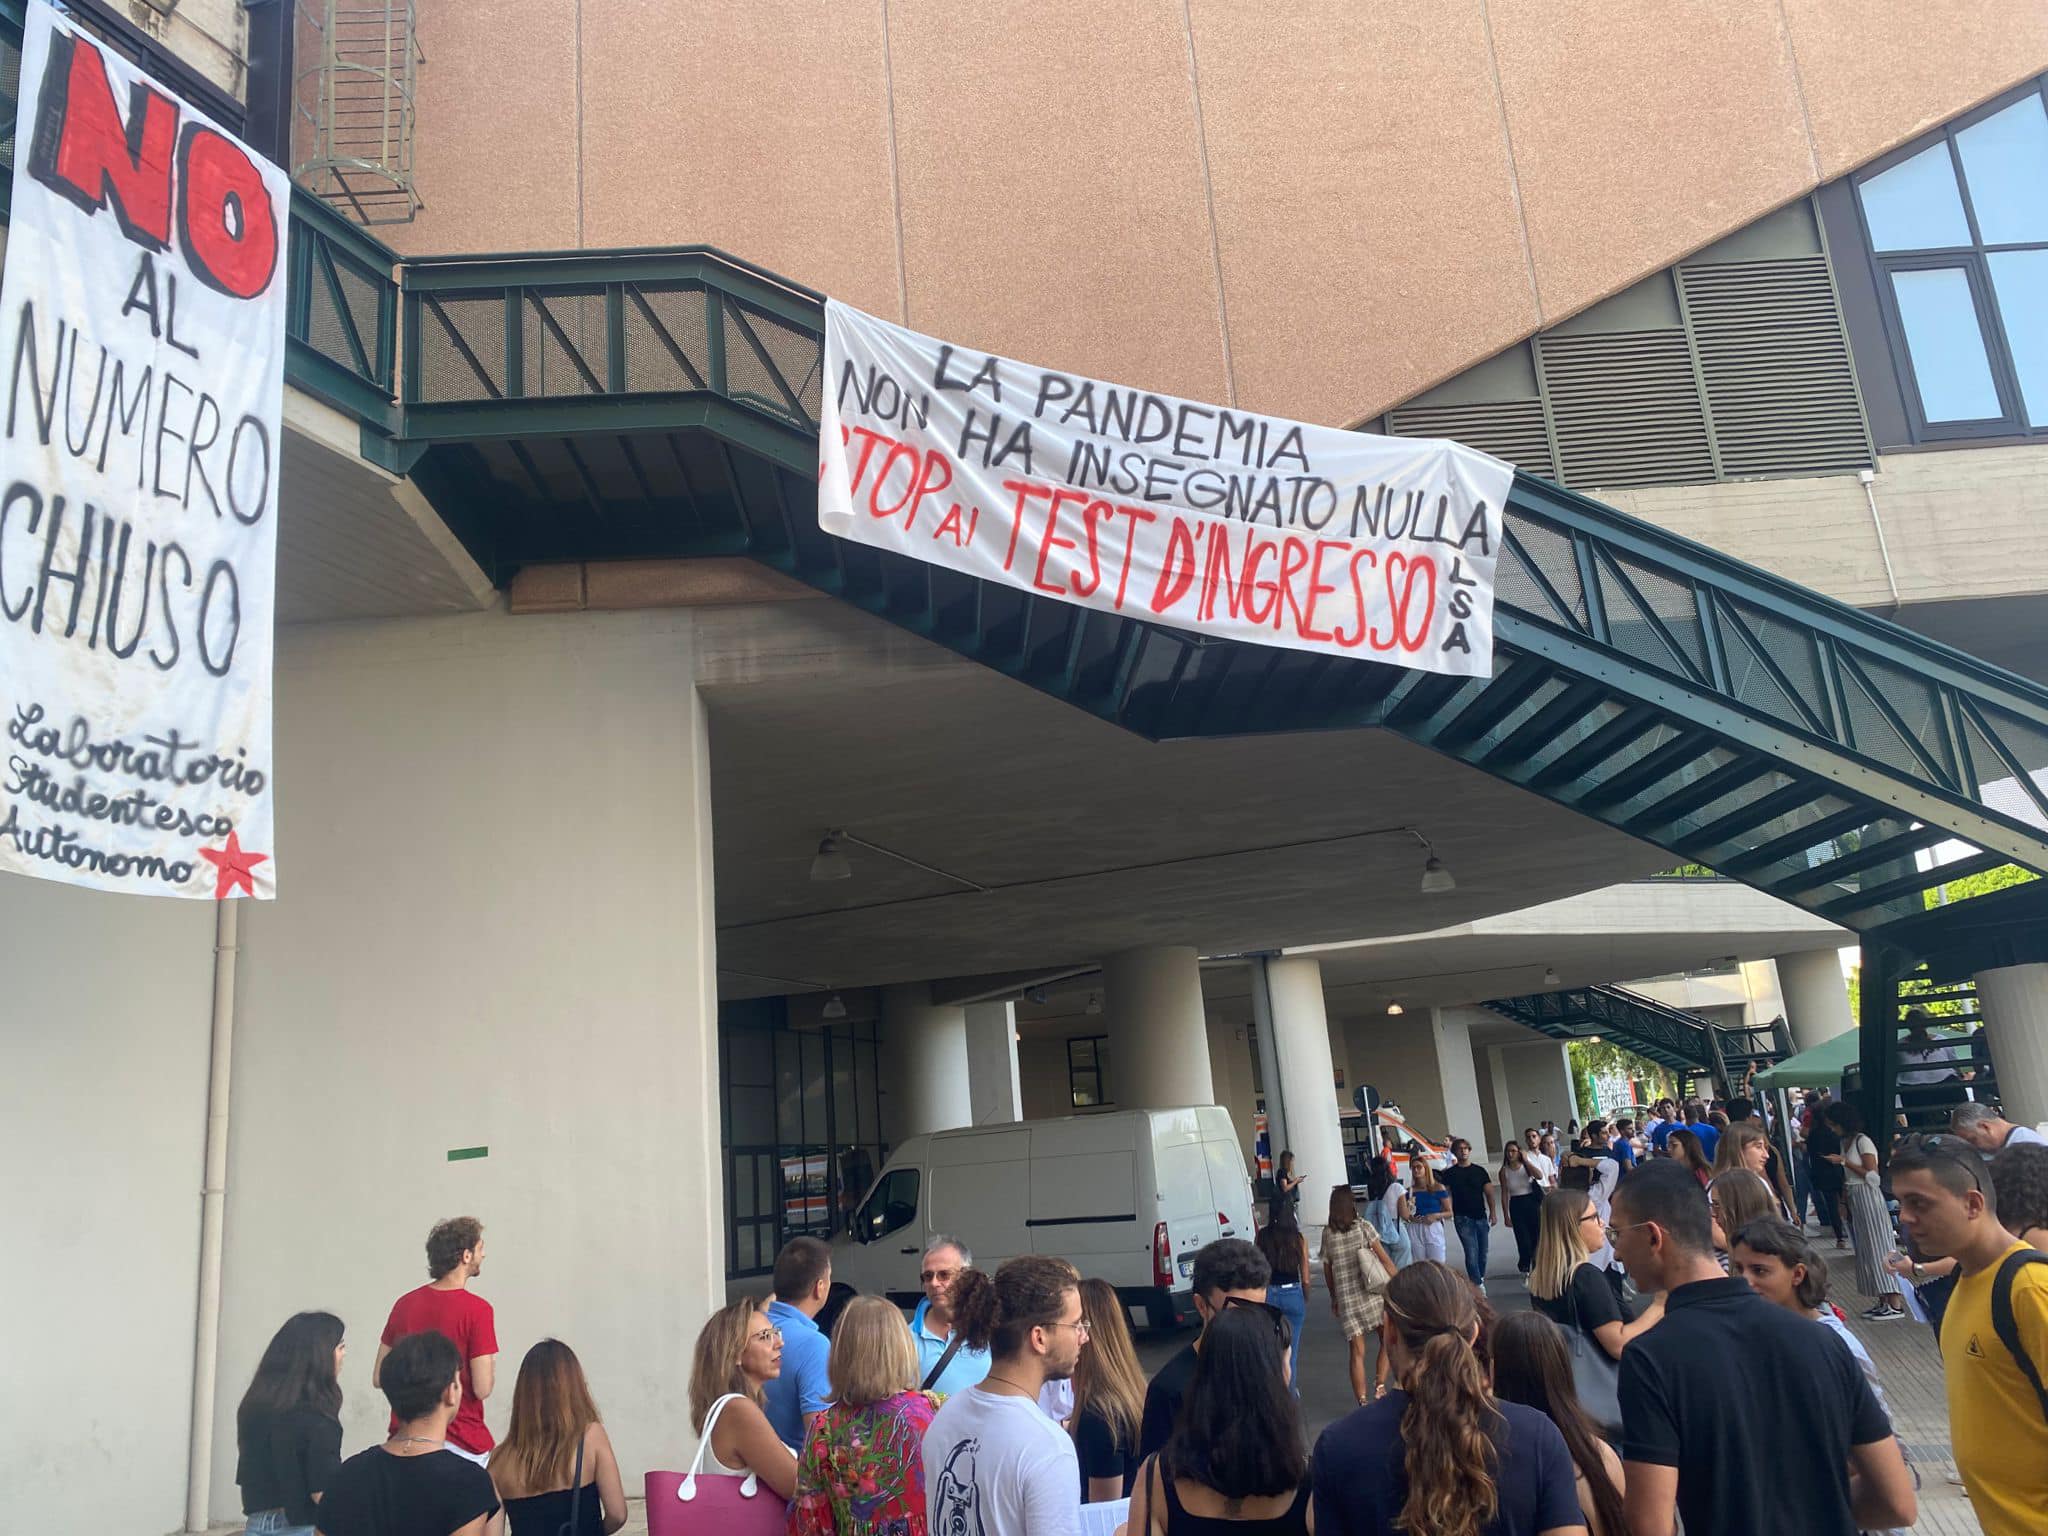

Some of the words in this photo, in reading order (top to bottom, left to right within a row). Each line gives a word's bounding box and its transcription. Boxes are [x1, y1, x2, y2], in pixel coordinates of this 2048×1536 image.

[28, 26, 278, 299] NO
[122, 252, 199, 359] AL
[6, 300, 270, 525] NUMERO
[838, 359, 928, 431] NON
[957, 409, 1033, 474] HA
[1066, 440, 1337, 530] INSEGNATO
[1350, 484, 1489, 556] NULLA
[935, 345, 1000, 402] LA
[1035, 375, 1309, 473] PANDEMIA
[0, 482, 240, 677] CHIUSO
[841, 424, 953, 531] TOP
[933, 504, 979, 547] AI
[1003, 480, 1156, 610] TEST
[1150, 516, 1436, 652] D'INGRESSO
[4, 756, 233, 836] Studentesco
[9, 703, 264, 795] Laboratorio
[0, 806, 196, 883] Autonomo
